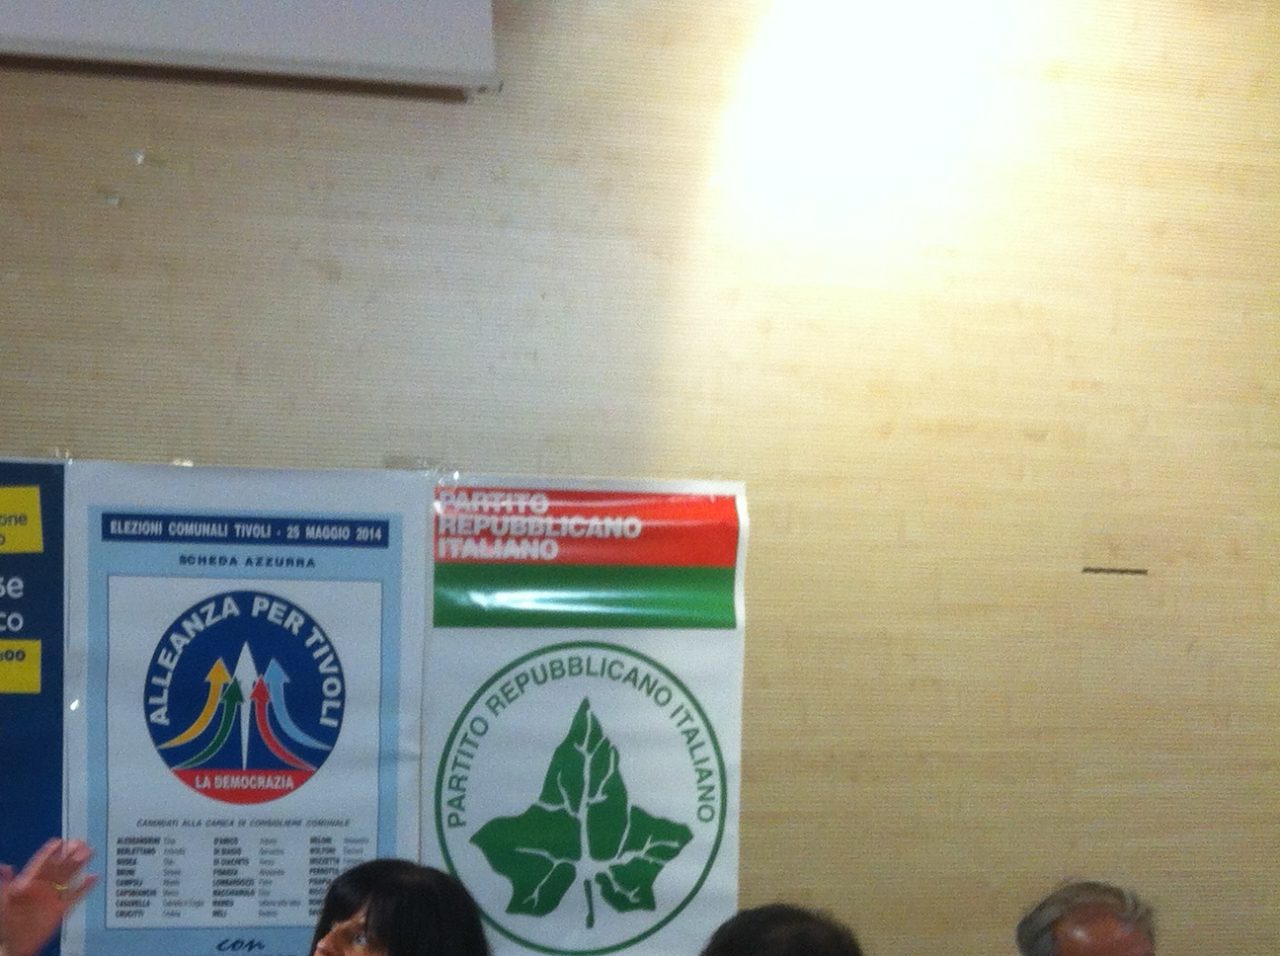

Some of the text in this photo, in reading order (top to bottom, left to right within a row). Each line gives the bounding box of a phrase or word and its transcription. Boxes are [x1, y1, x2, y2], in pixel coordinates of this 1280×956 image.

[439, 491, 549, 514] PARTITO
[110, 519, 382, 542] ELEZIONI COMUNALI TIVOLI 25 MAGGIO 2014
[438, 514, 643, 539] REPUBBLICANO
[438, 537, 559, 561] ITALIANO
[179, 554, 316, 569] SCHEDA AZZURRA
[149, 595, 342, 728] ALLEANZA PER TIVOLI
[447, 655, 716, 828] PARTITO REPUBBLICANO ITALIANO
[194, 775, 294, 791] LA DEMOCRAZIA
[215, 938, 266, 952] con
